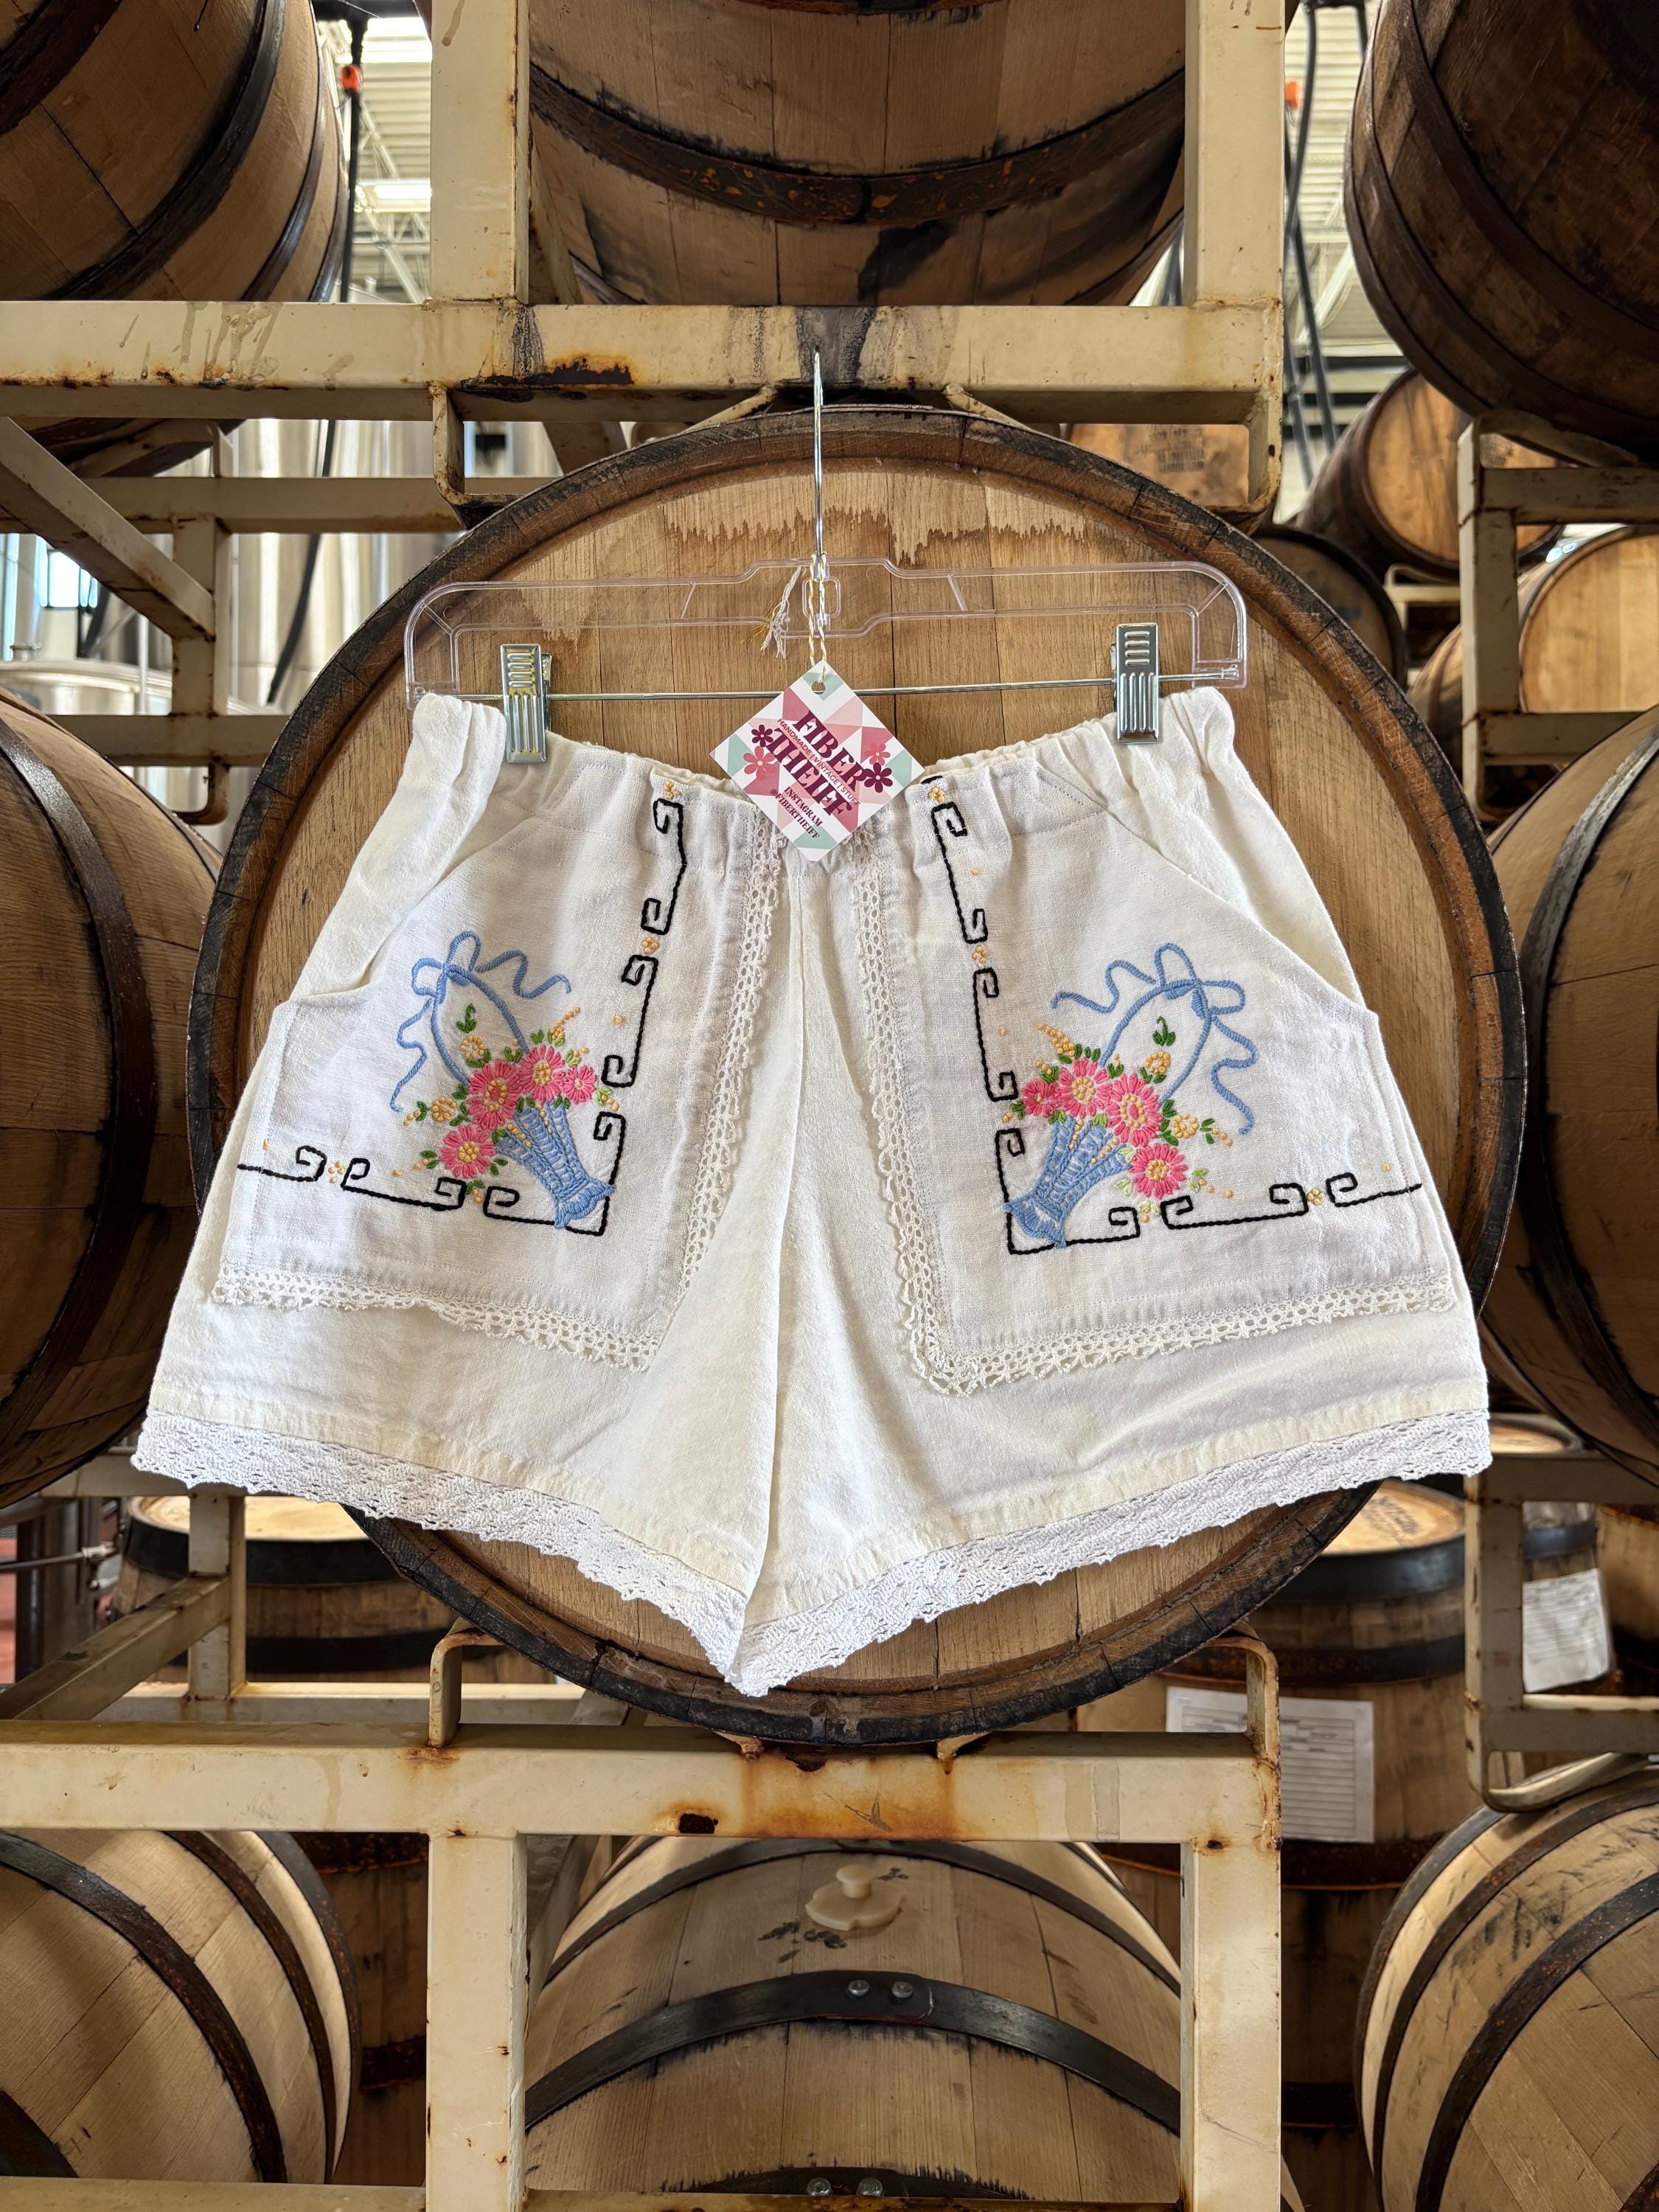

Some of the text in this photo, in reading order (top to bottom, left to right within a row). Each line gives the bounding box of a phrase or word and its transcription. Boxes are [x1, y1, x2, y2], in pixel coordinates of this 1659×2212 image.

[766, 728, 852, 815] THEIFF
[777, 718, 812, 756] HANDMADE
[813, 757, 841, 785] VINTAGE
[841, 786, 860, 806] STUFF
[792, 709, 867, 792] FIBER
[771, 789, 820, 838] @FIBERTHEIFF
[784, 787, 823, 827] INSTAGRAM
